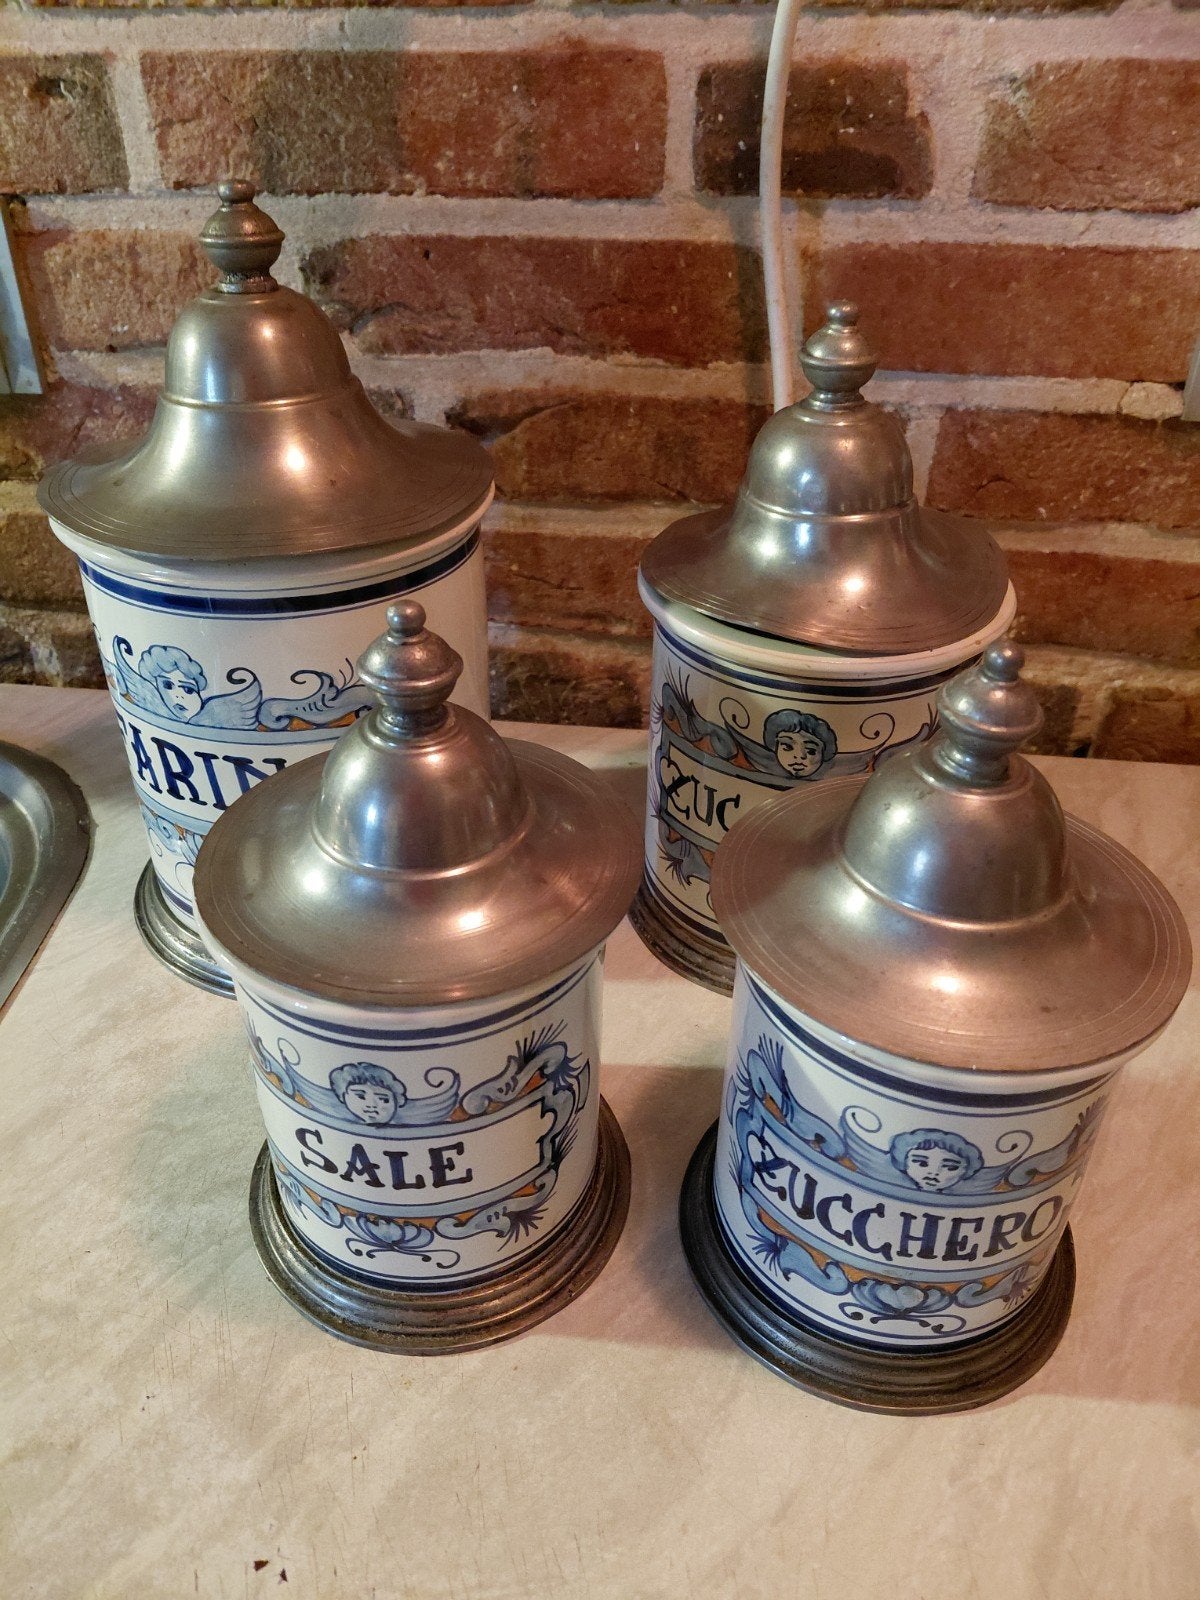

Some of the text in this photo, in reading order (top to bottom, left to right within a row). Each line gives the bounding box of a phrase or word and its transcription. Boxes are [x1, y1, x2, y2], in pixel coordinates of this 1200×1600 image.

[115, 709, 287, 811] ARIN
[295, 1127, 474, 1190] SALE
[753, 1135, 1064, 1262] ZUCCHERO
